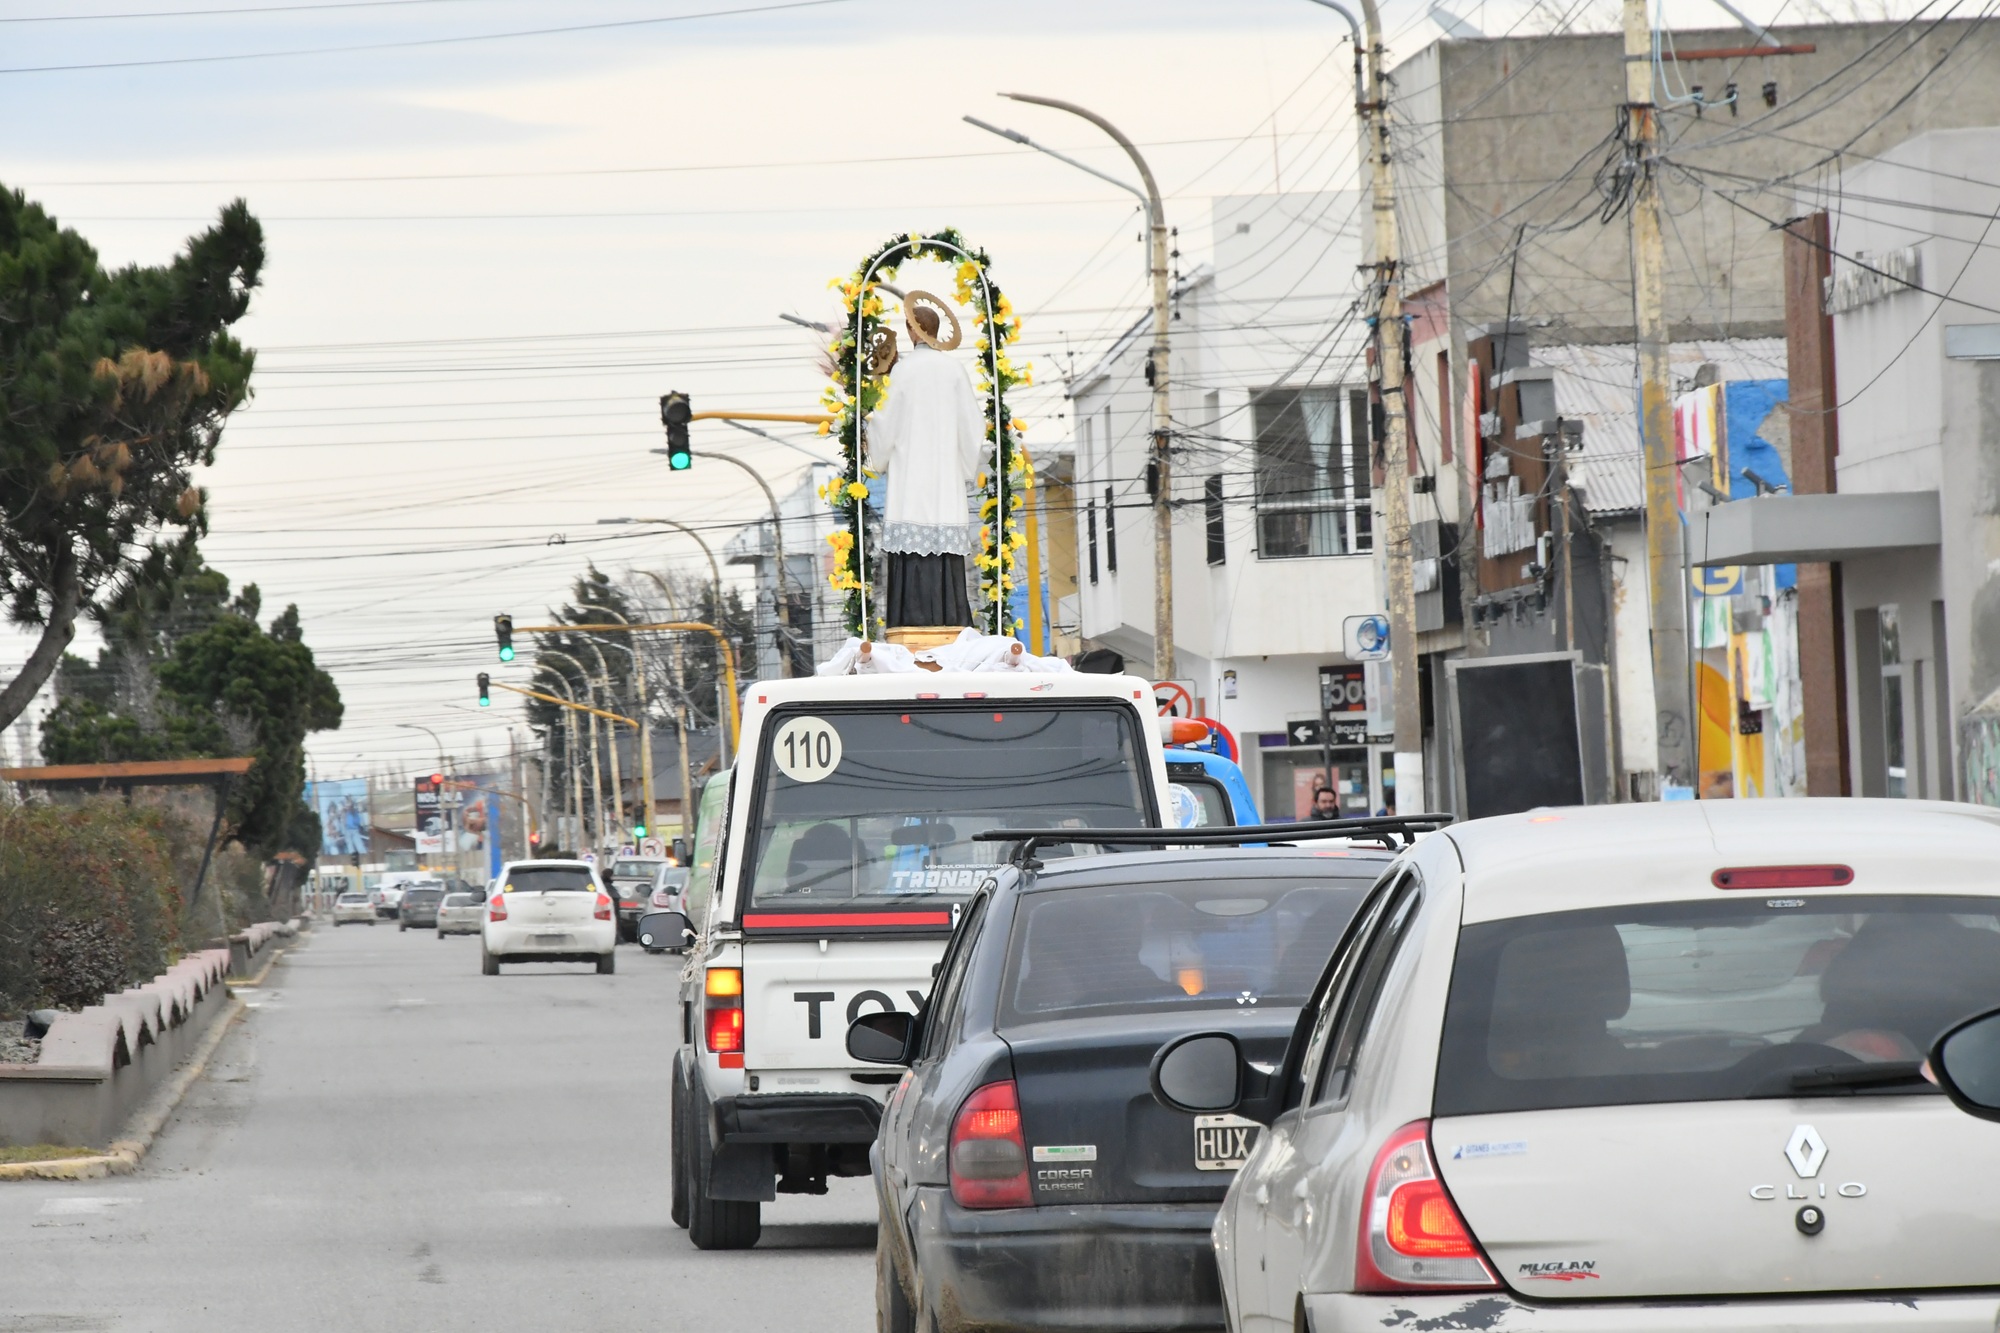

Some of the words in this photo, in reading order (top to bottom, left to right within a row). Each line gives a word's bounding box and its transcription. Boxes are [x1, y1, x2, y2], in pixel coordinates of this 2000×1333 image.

[784, 731, 831, 768] 110
[892, 870, 994, 888] TRONAD
[1200, 1128, 1249, 1159] HUX
[1037, 1168, 1093, 1180] CORSA
[1038, 1182, 1085, 1191] CLASSIC
[1749, 1181, 1868, 1201] CLIO
[1518, 1260, 1596, 1273] MUGLAN
